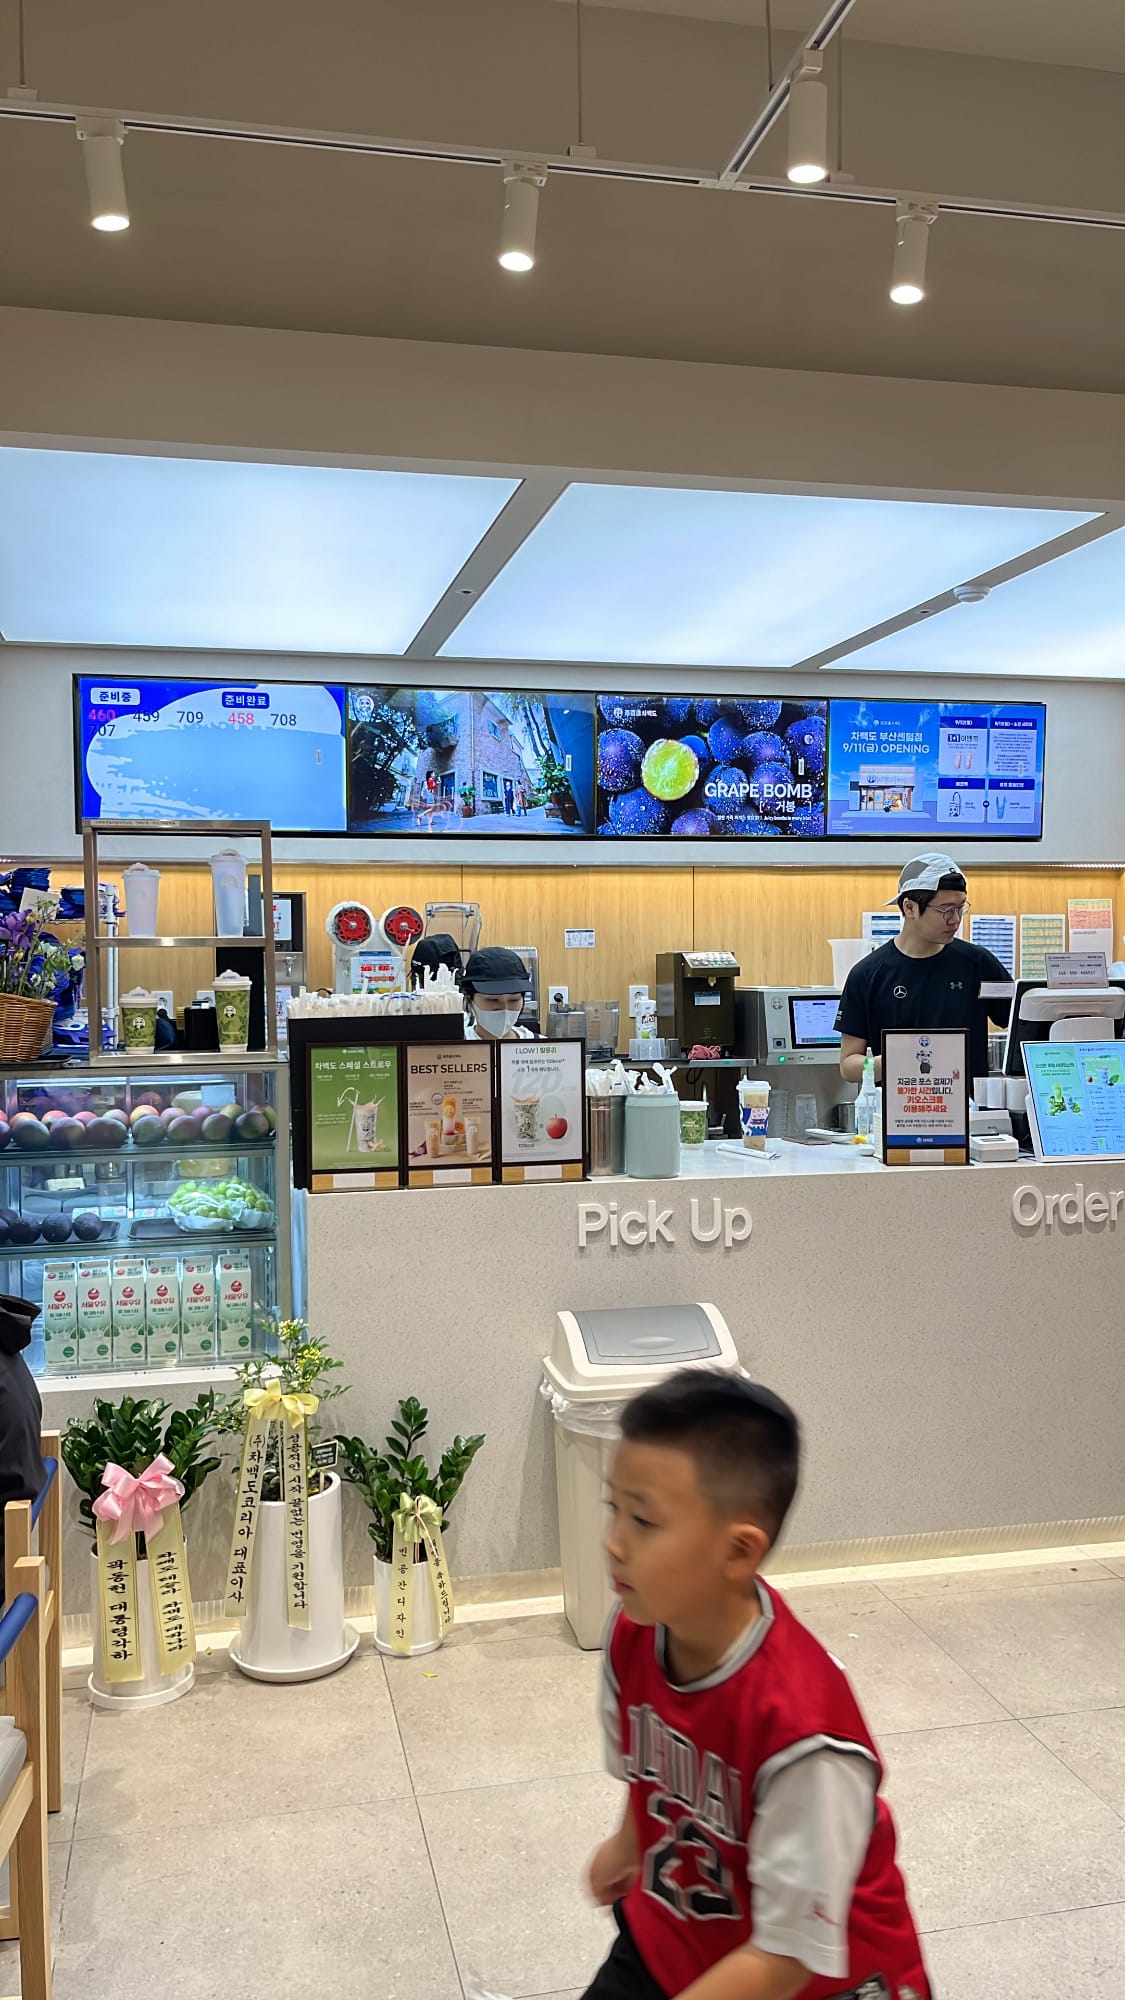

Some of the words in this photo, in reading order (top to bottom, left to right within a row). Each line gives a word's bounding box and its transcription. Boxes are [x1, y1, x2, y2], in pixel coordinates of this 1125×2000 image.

[99, 691, 132, 702] 준비중
[224, 694, 267, 706] 준비완료
[88, 709, 116, 721] 460
[132, 711, 160, 723] 459
[176, 711, 204, 724] 709
[228, 713, 255, 725] 458
[270, 714, 297, 726] 708
[842, 743, 879, 753] 9/11(금)
[880, 743, 930, 754] OPENING
[704, 783, 760, 798] GRAPE
[763, 783, 813, 798] BOMB
[362, 1060, 392, 1069] 스트로우
[410, 1064, 439, 1074] BEST
[440, 1063, 488, 1073] SELLERS
[897, 1078, 917, 1086] 지금은
[903, 1104, 948, 1113] 이용해주세요
[1012, 1183, 1125, 1227] Order
[577, 1199, 675, 1248] Pick
[690, 1197, 753, 1247] Up
[288, 1475, 304, 1494] 시작
[227, 1545, 248, 1604] 대표이사
[290, 1562, 309, 1609] 기원합니다
